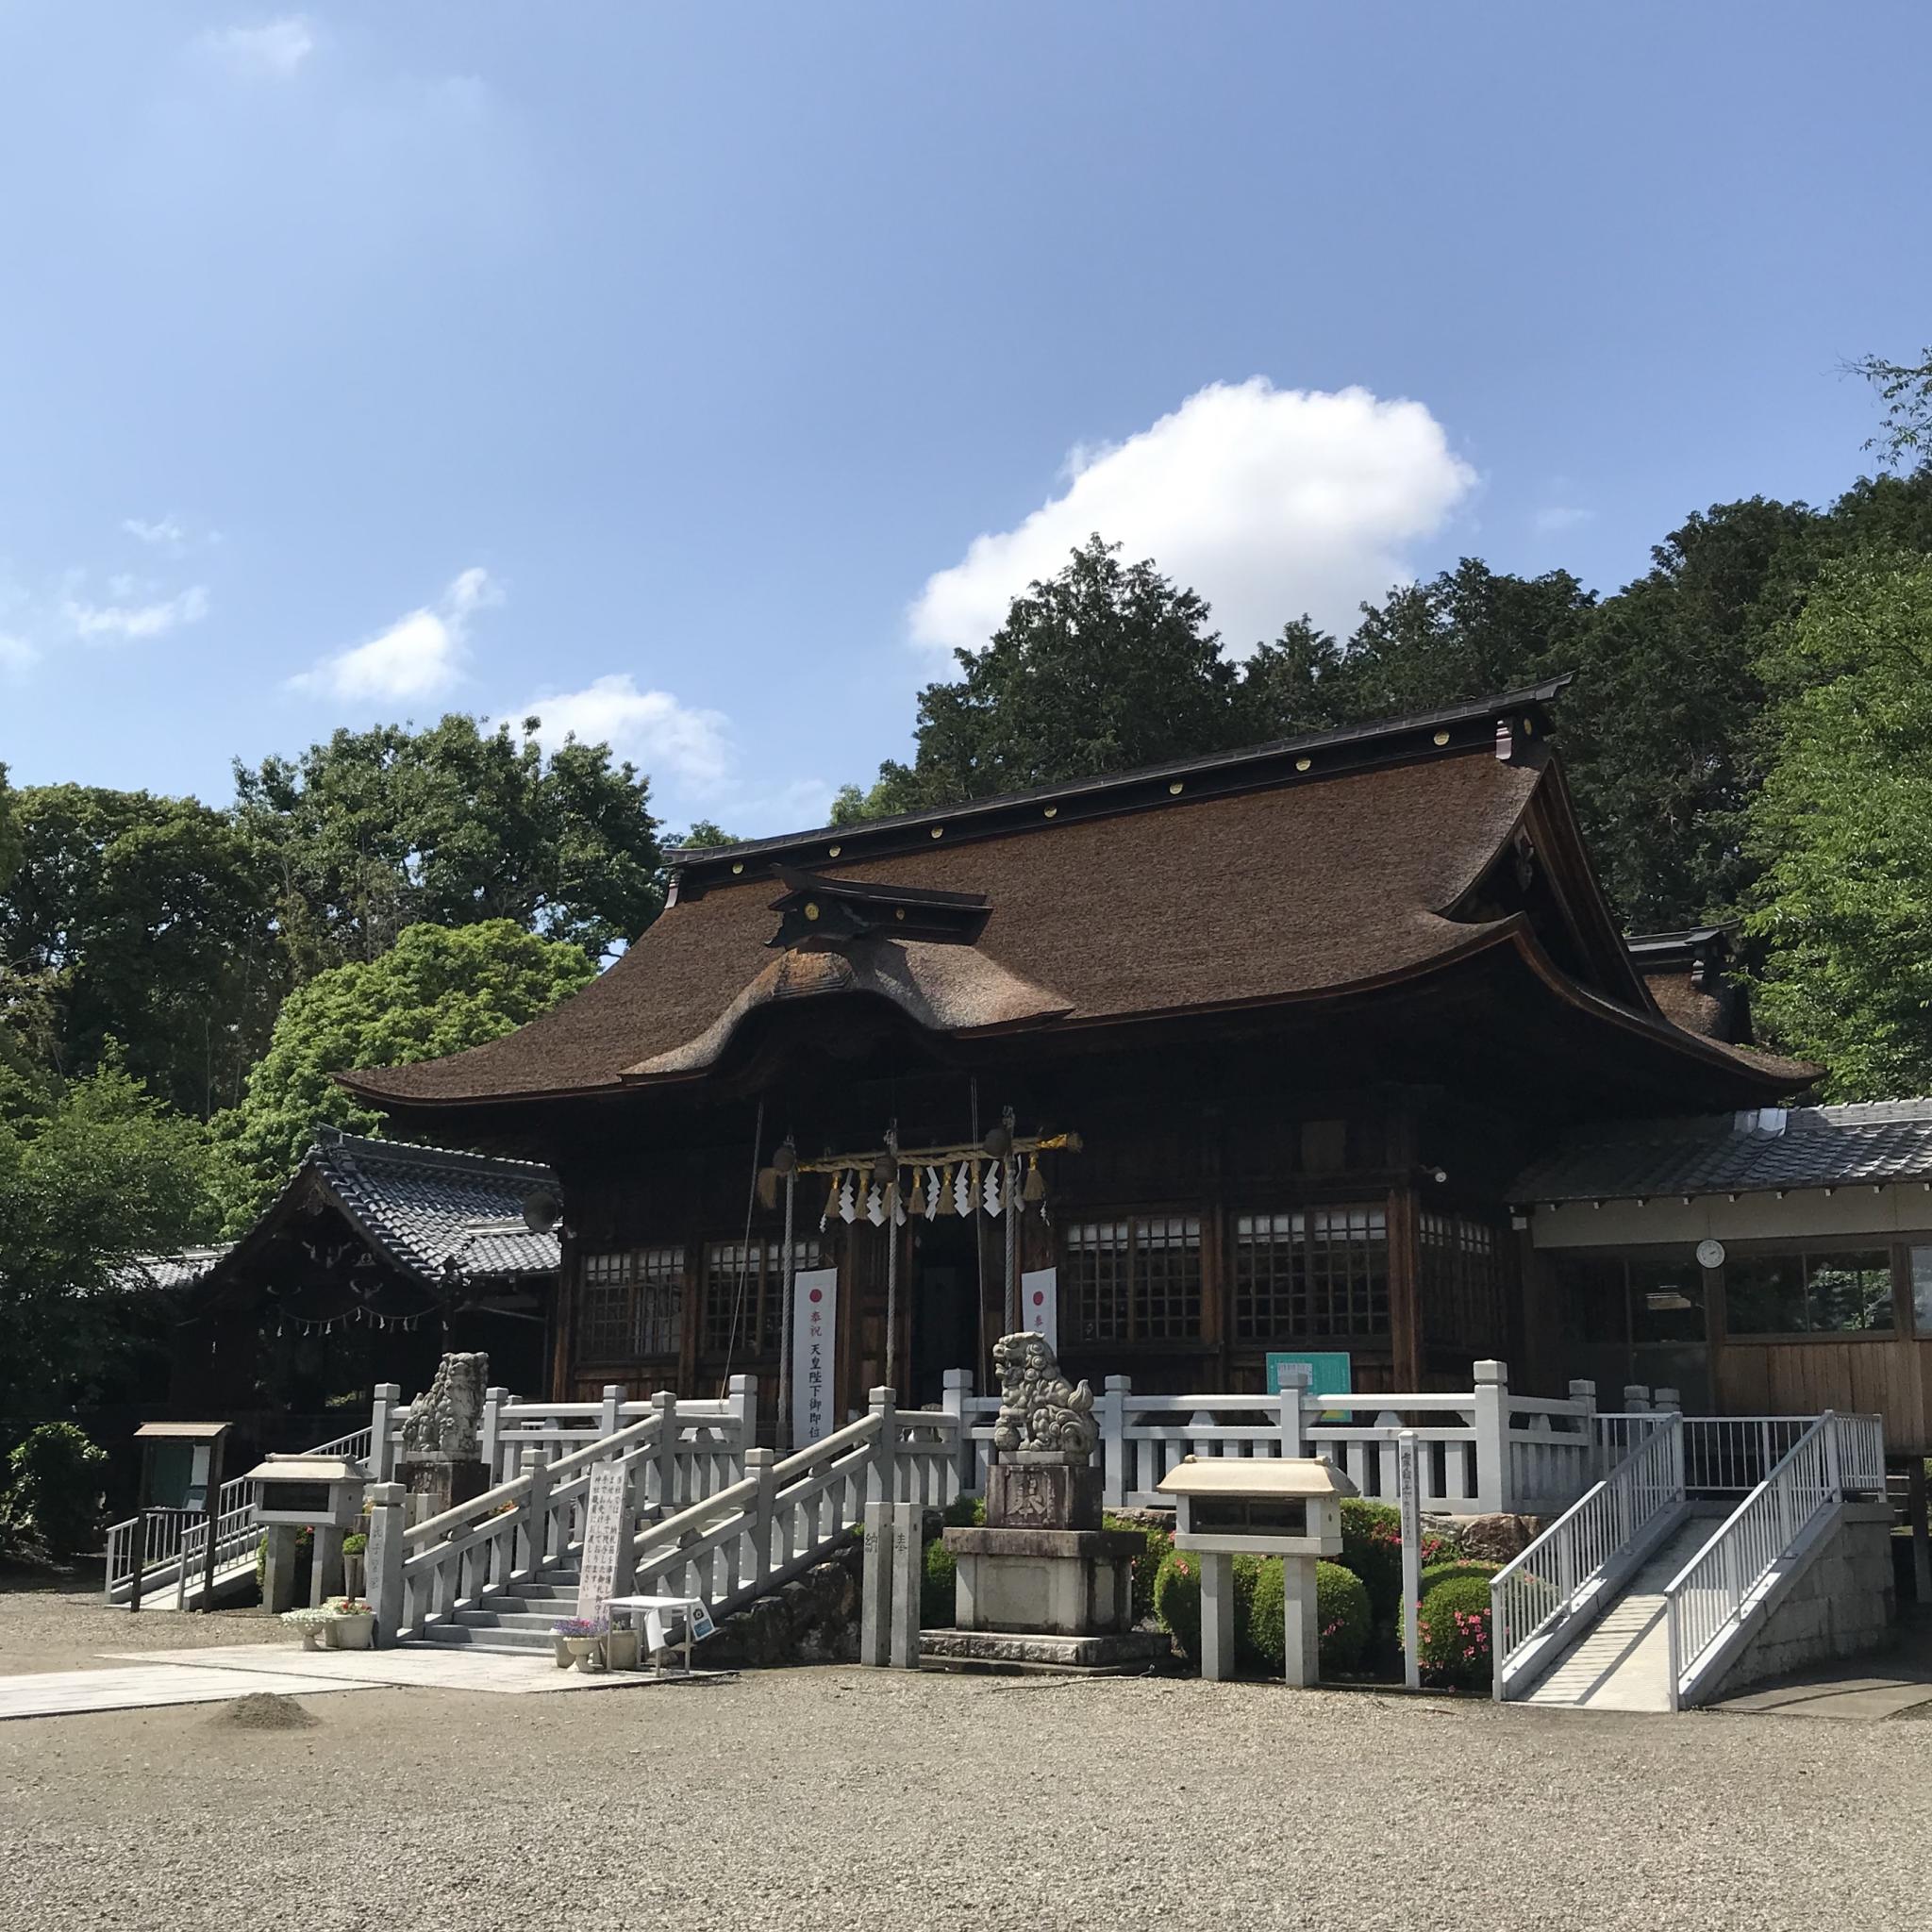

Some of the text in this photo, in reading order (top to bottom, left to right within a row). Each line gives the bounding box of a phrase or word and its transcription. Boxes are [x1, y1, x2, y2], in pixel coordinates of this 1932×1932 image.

[808, 1311, 823, 1439] 奉祝 天皇陛下御即位
[865, 1532, 878, 1554] 納
[895, 1532, 907, 1554] 奉
